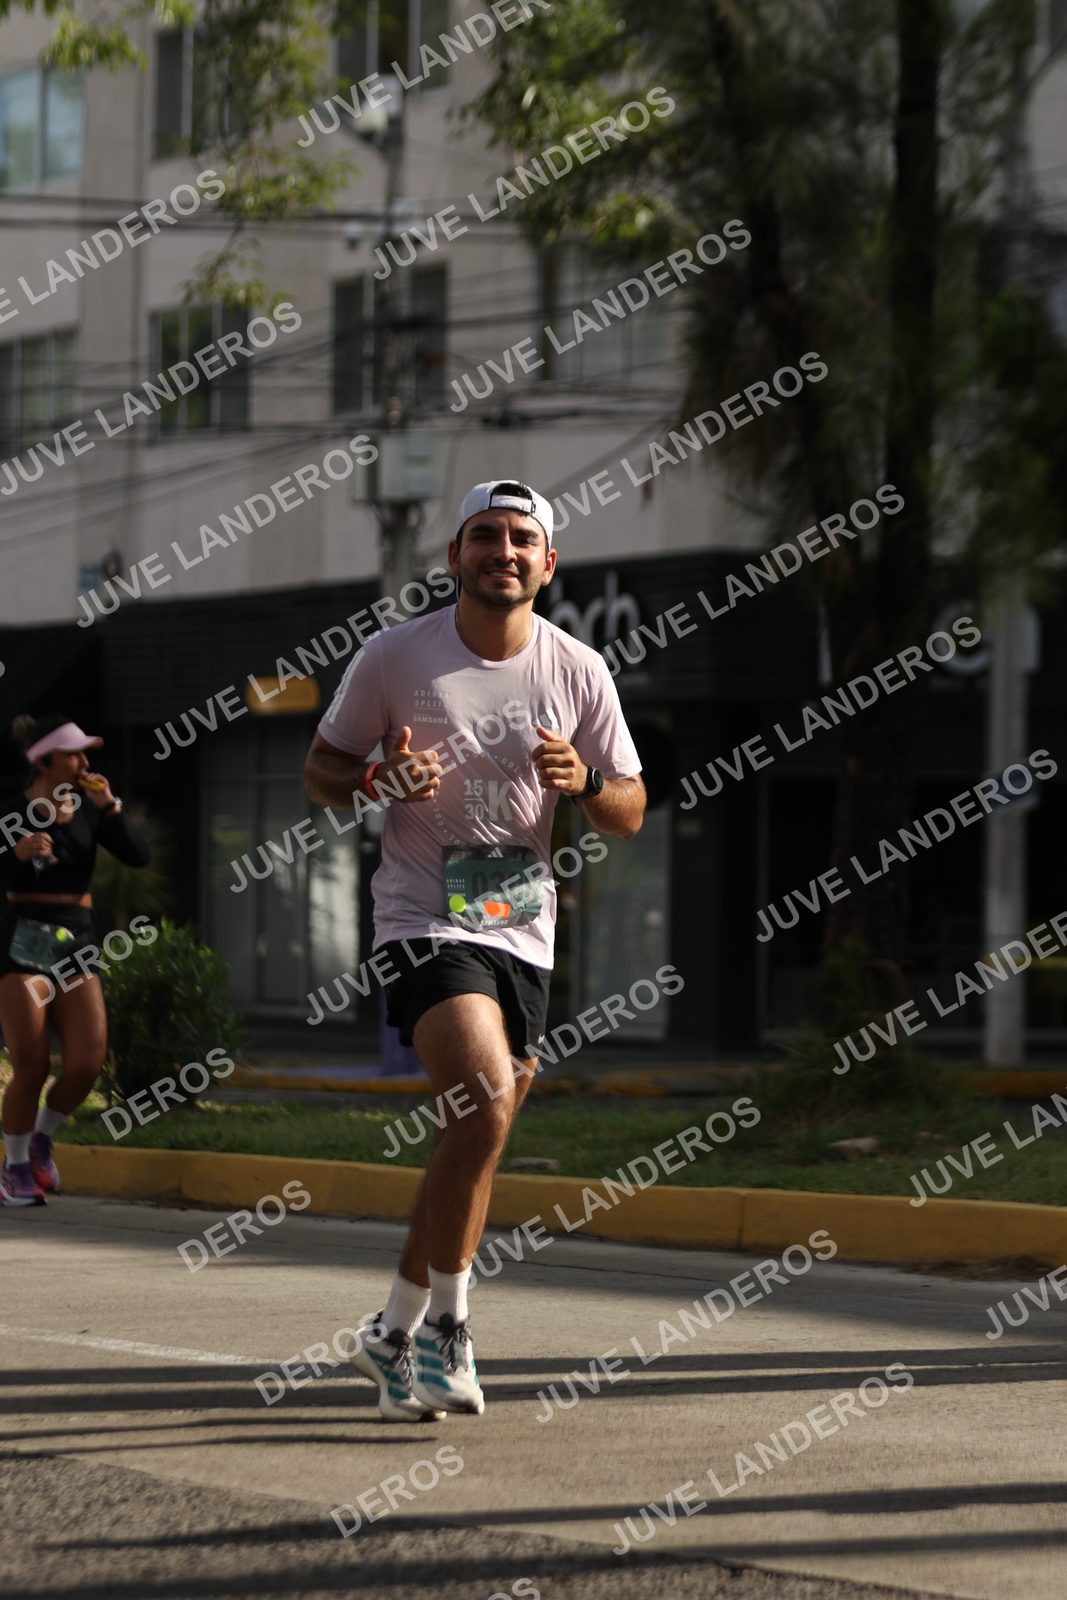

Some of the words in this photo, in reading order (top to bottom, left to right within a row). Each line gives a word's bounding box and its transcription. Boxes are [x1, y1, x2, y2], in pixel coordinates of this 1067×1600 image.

[464, 778, 484, 797] 15
[488, 780, 515, 822] K
[464, 803, 485, 821] 30
